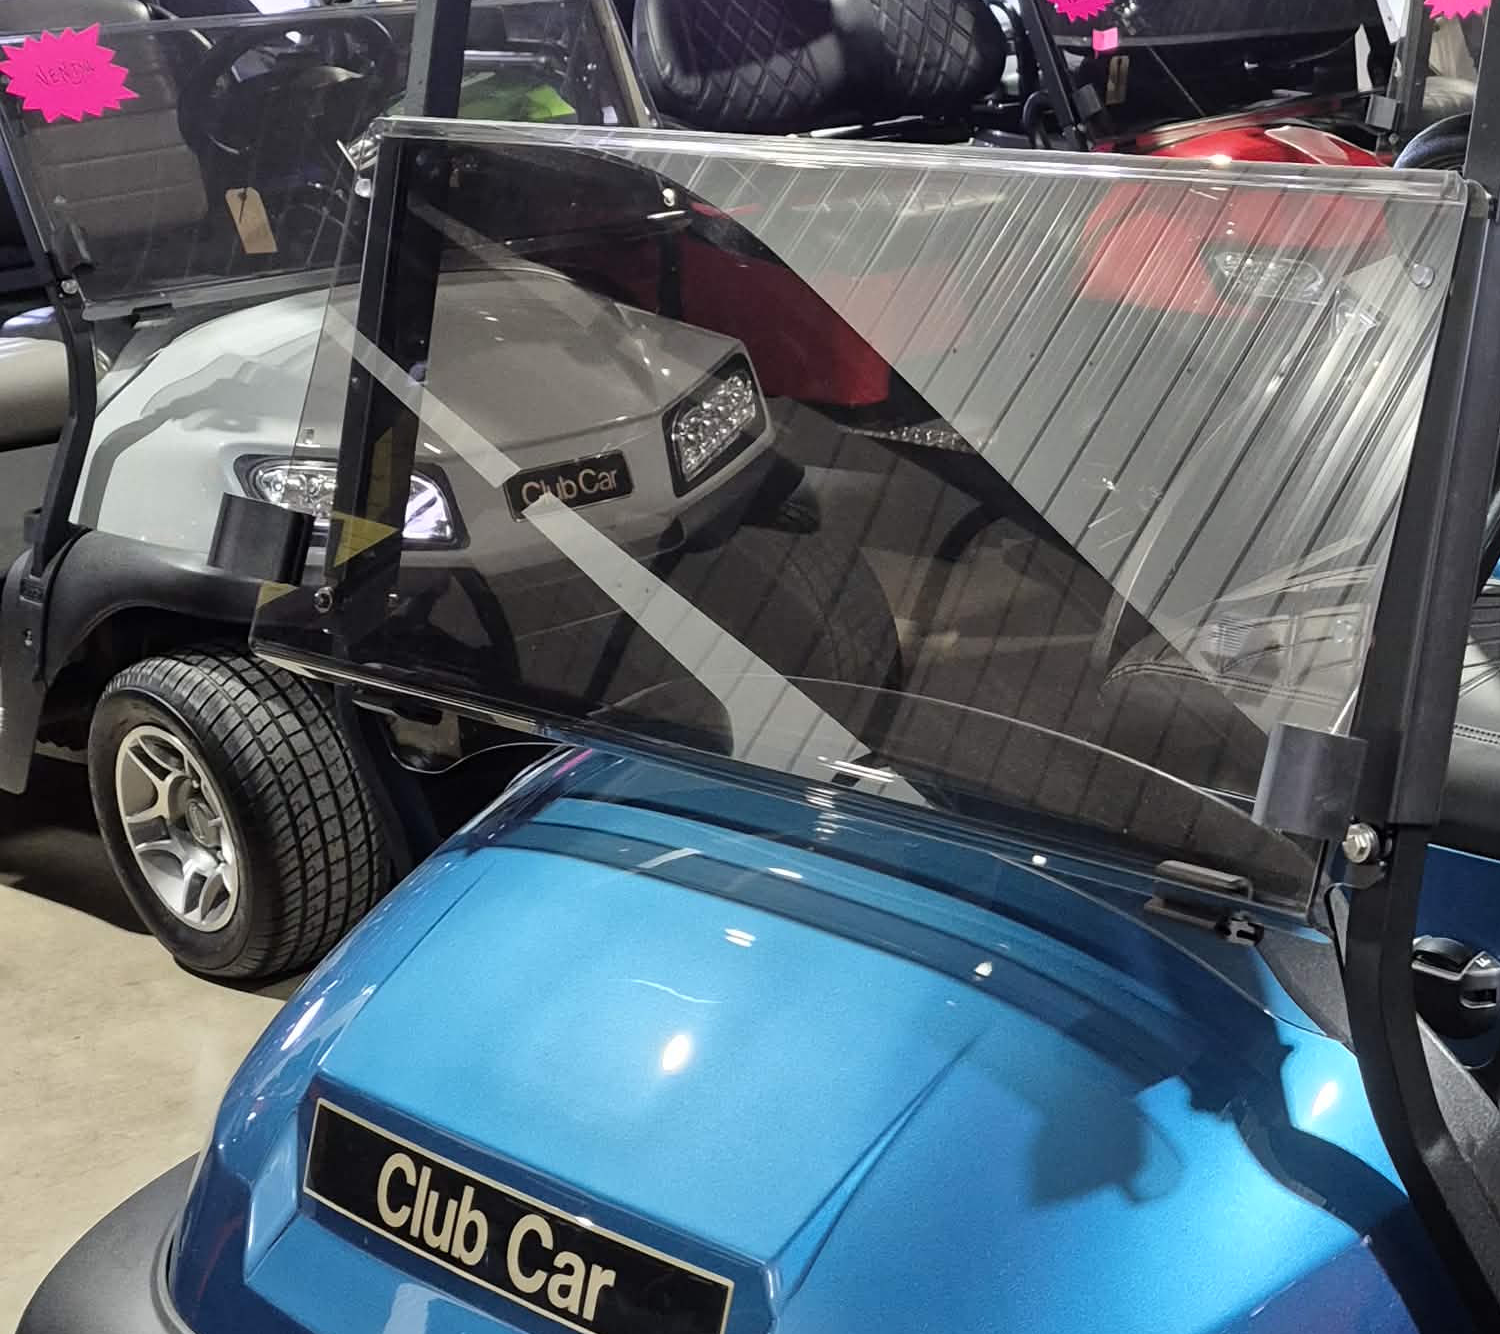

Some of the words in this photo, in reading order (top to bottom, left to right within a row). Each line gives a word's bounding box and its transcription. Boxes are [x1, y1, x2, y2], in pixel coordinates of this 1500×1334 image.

[578, 468, 618, 495] Car
[377, 1152, 489, 1267] Club
[506, 1213, 617, 1322] Car
